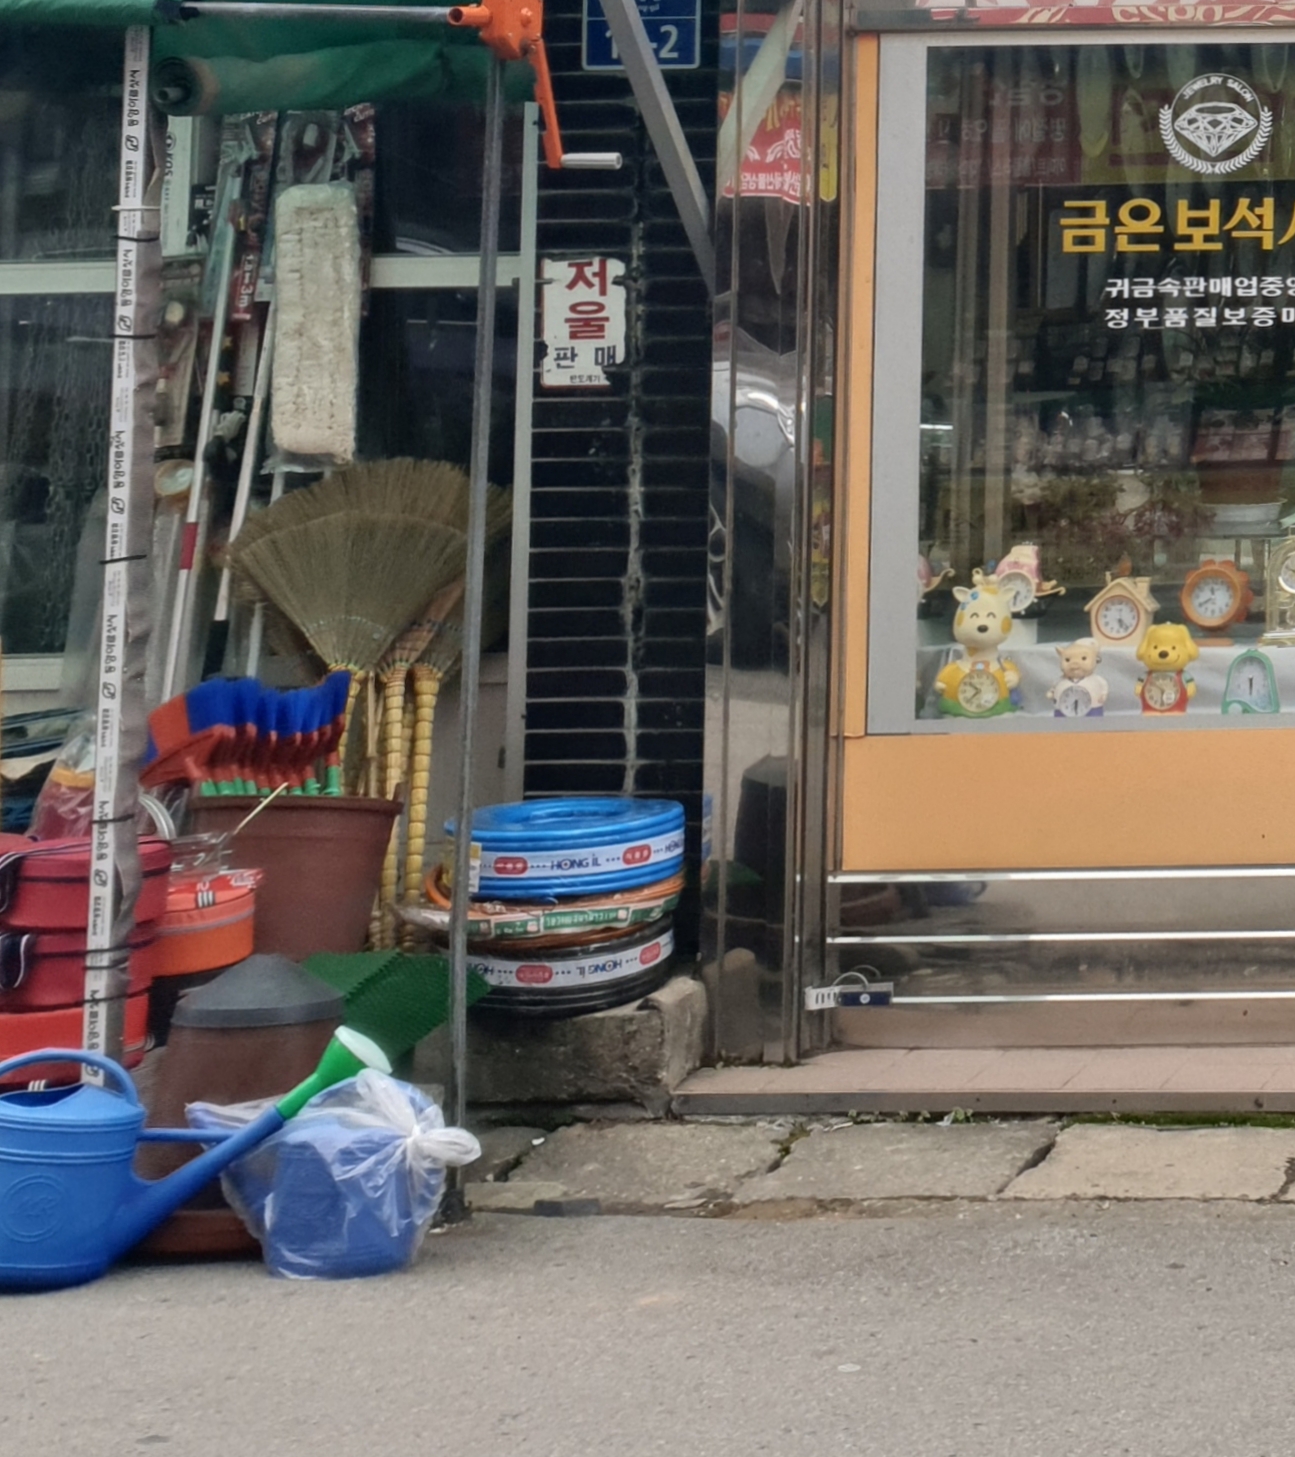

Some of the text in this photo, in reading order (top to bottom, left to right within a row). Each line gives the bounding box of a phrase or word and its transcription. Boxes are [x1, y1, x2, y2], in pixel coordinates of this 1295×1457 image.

[1182, 76, 1255, 103] JEWELRY SALON
[564, 257, 611, 341] 저울
[553, 344, 617, 370] 판매
